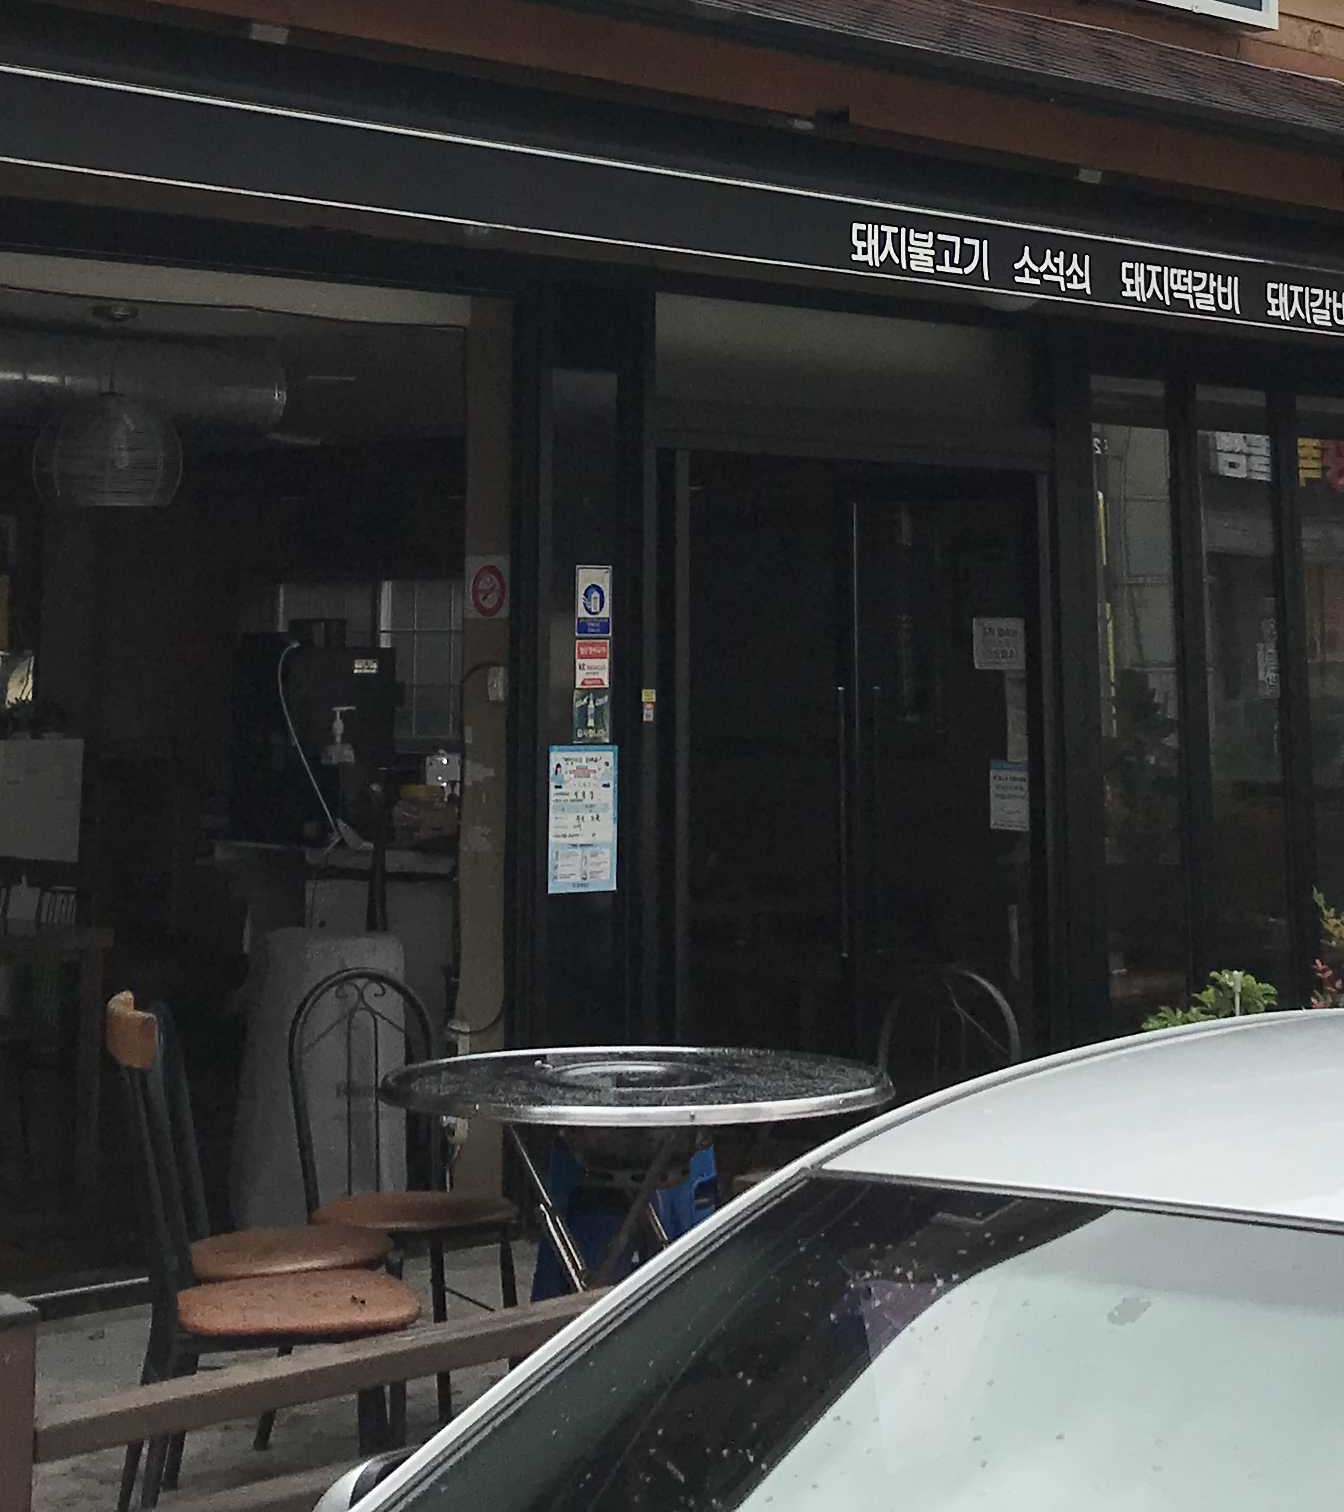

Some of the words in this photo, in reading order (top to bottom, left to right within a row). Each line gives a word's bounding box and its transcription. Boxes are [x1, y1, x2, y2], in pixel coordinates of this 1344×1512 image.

[851, 222, 990, 282] 돼지불고기
[1014, 245, 1091, 295] 소석쇠
[1121, 261, 1240, 315] 돼지떡갈비
